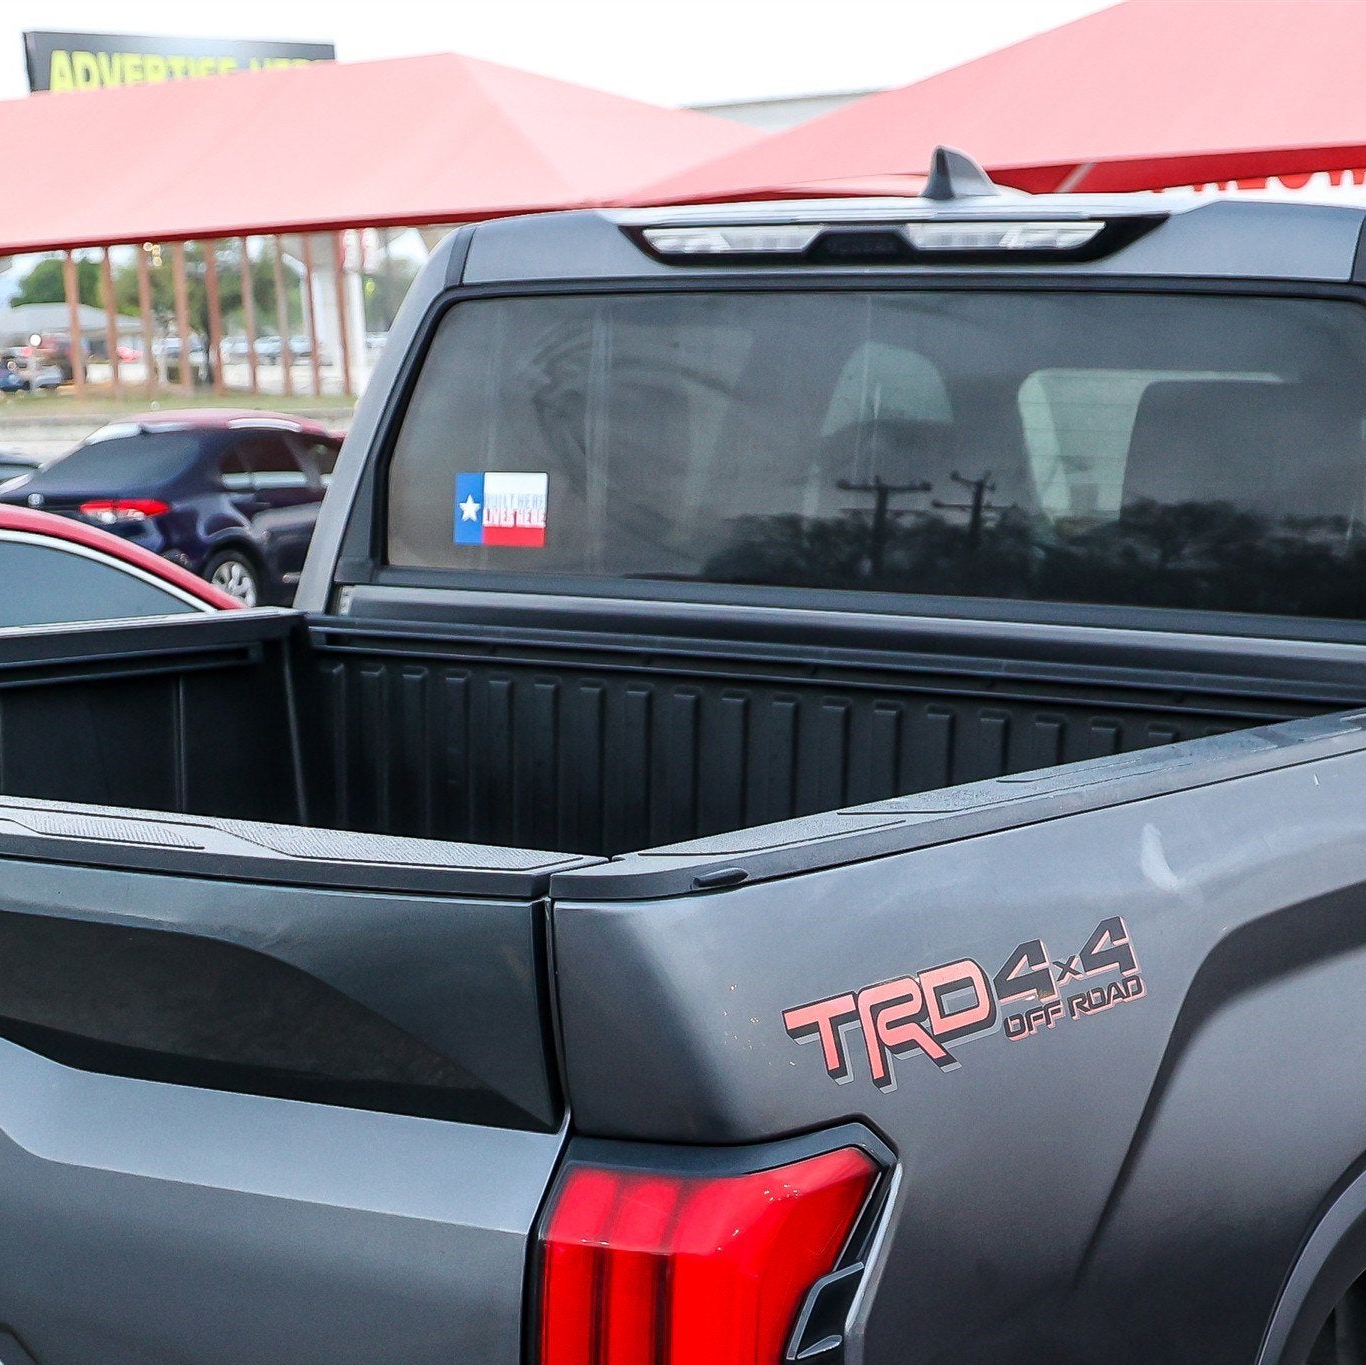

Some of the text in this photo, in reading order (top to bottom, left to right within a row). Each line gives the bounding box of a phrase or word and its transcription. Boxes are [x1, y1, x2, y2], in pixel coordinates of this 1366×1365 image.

[781, 915, 1142, 1095] TRD 4x4
[1003, 974, 1147, 1042] OFF ROAD
